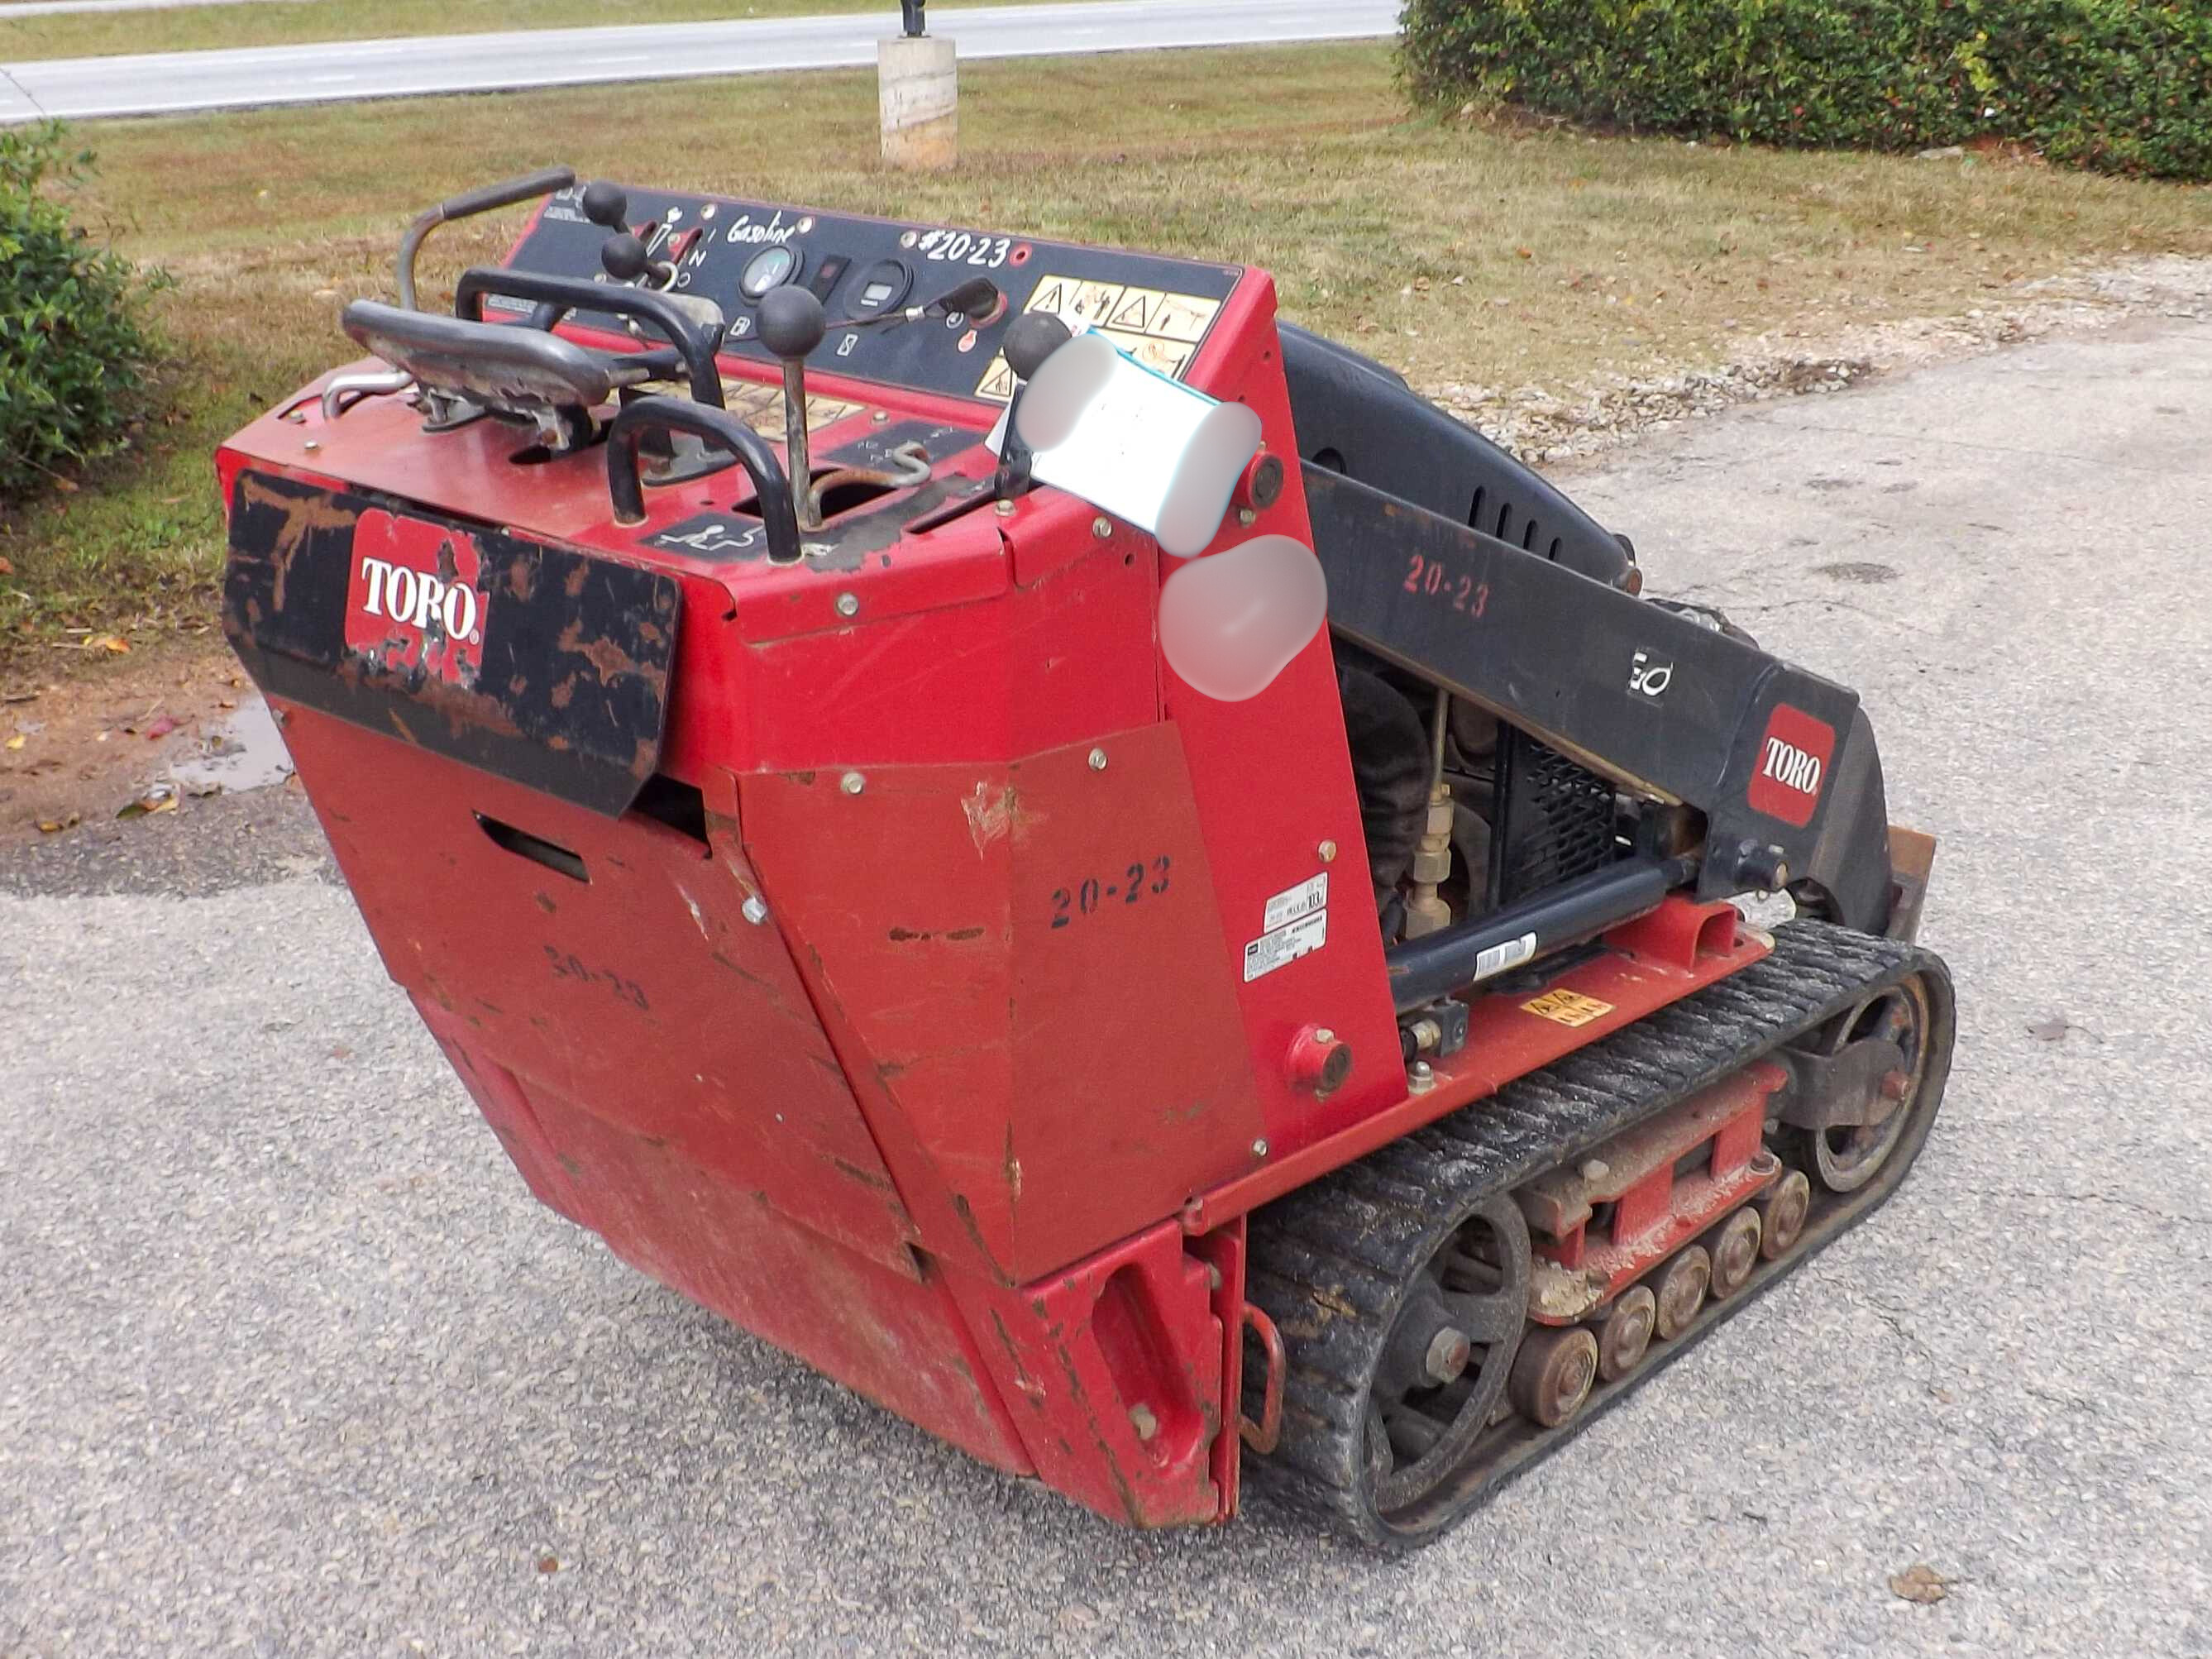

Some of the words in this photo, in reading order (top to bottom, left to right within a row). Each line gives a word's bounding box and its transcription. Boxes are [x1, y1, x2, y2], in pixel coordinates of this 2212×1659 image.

[361, 557, 477, 641] TORO
[1403, 554, 1489, 618] 20-23
[1762, 736, 1821, 794] TORO
[1051, 854, 1171, 929] 20-23
